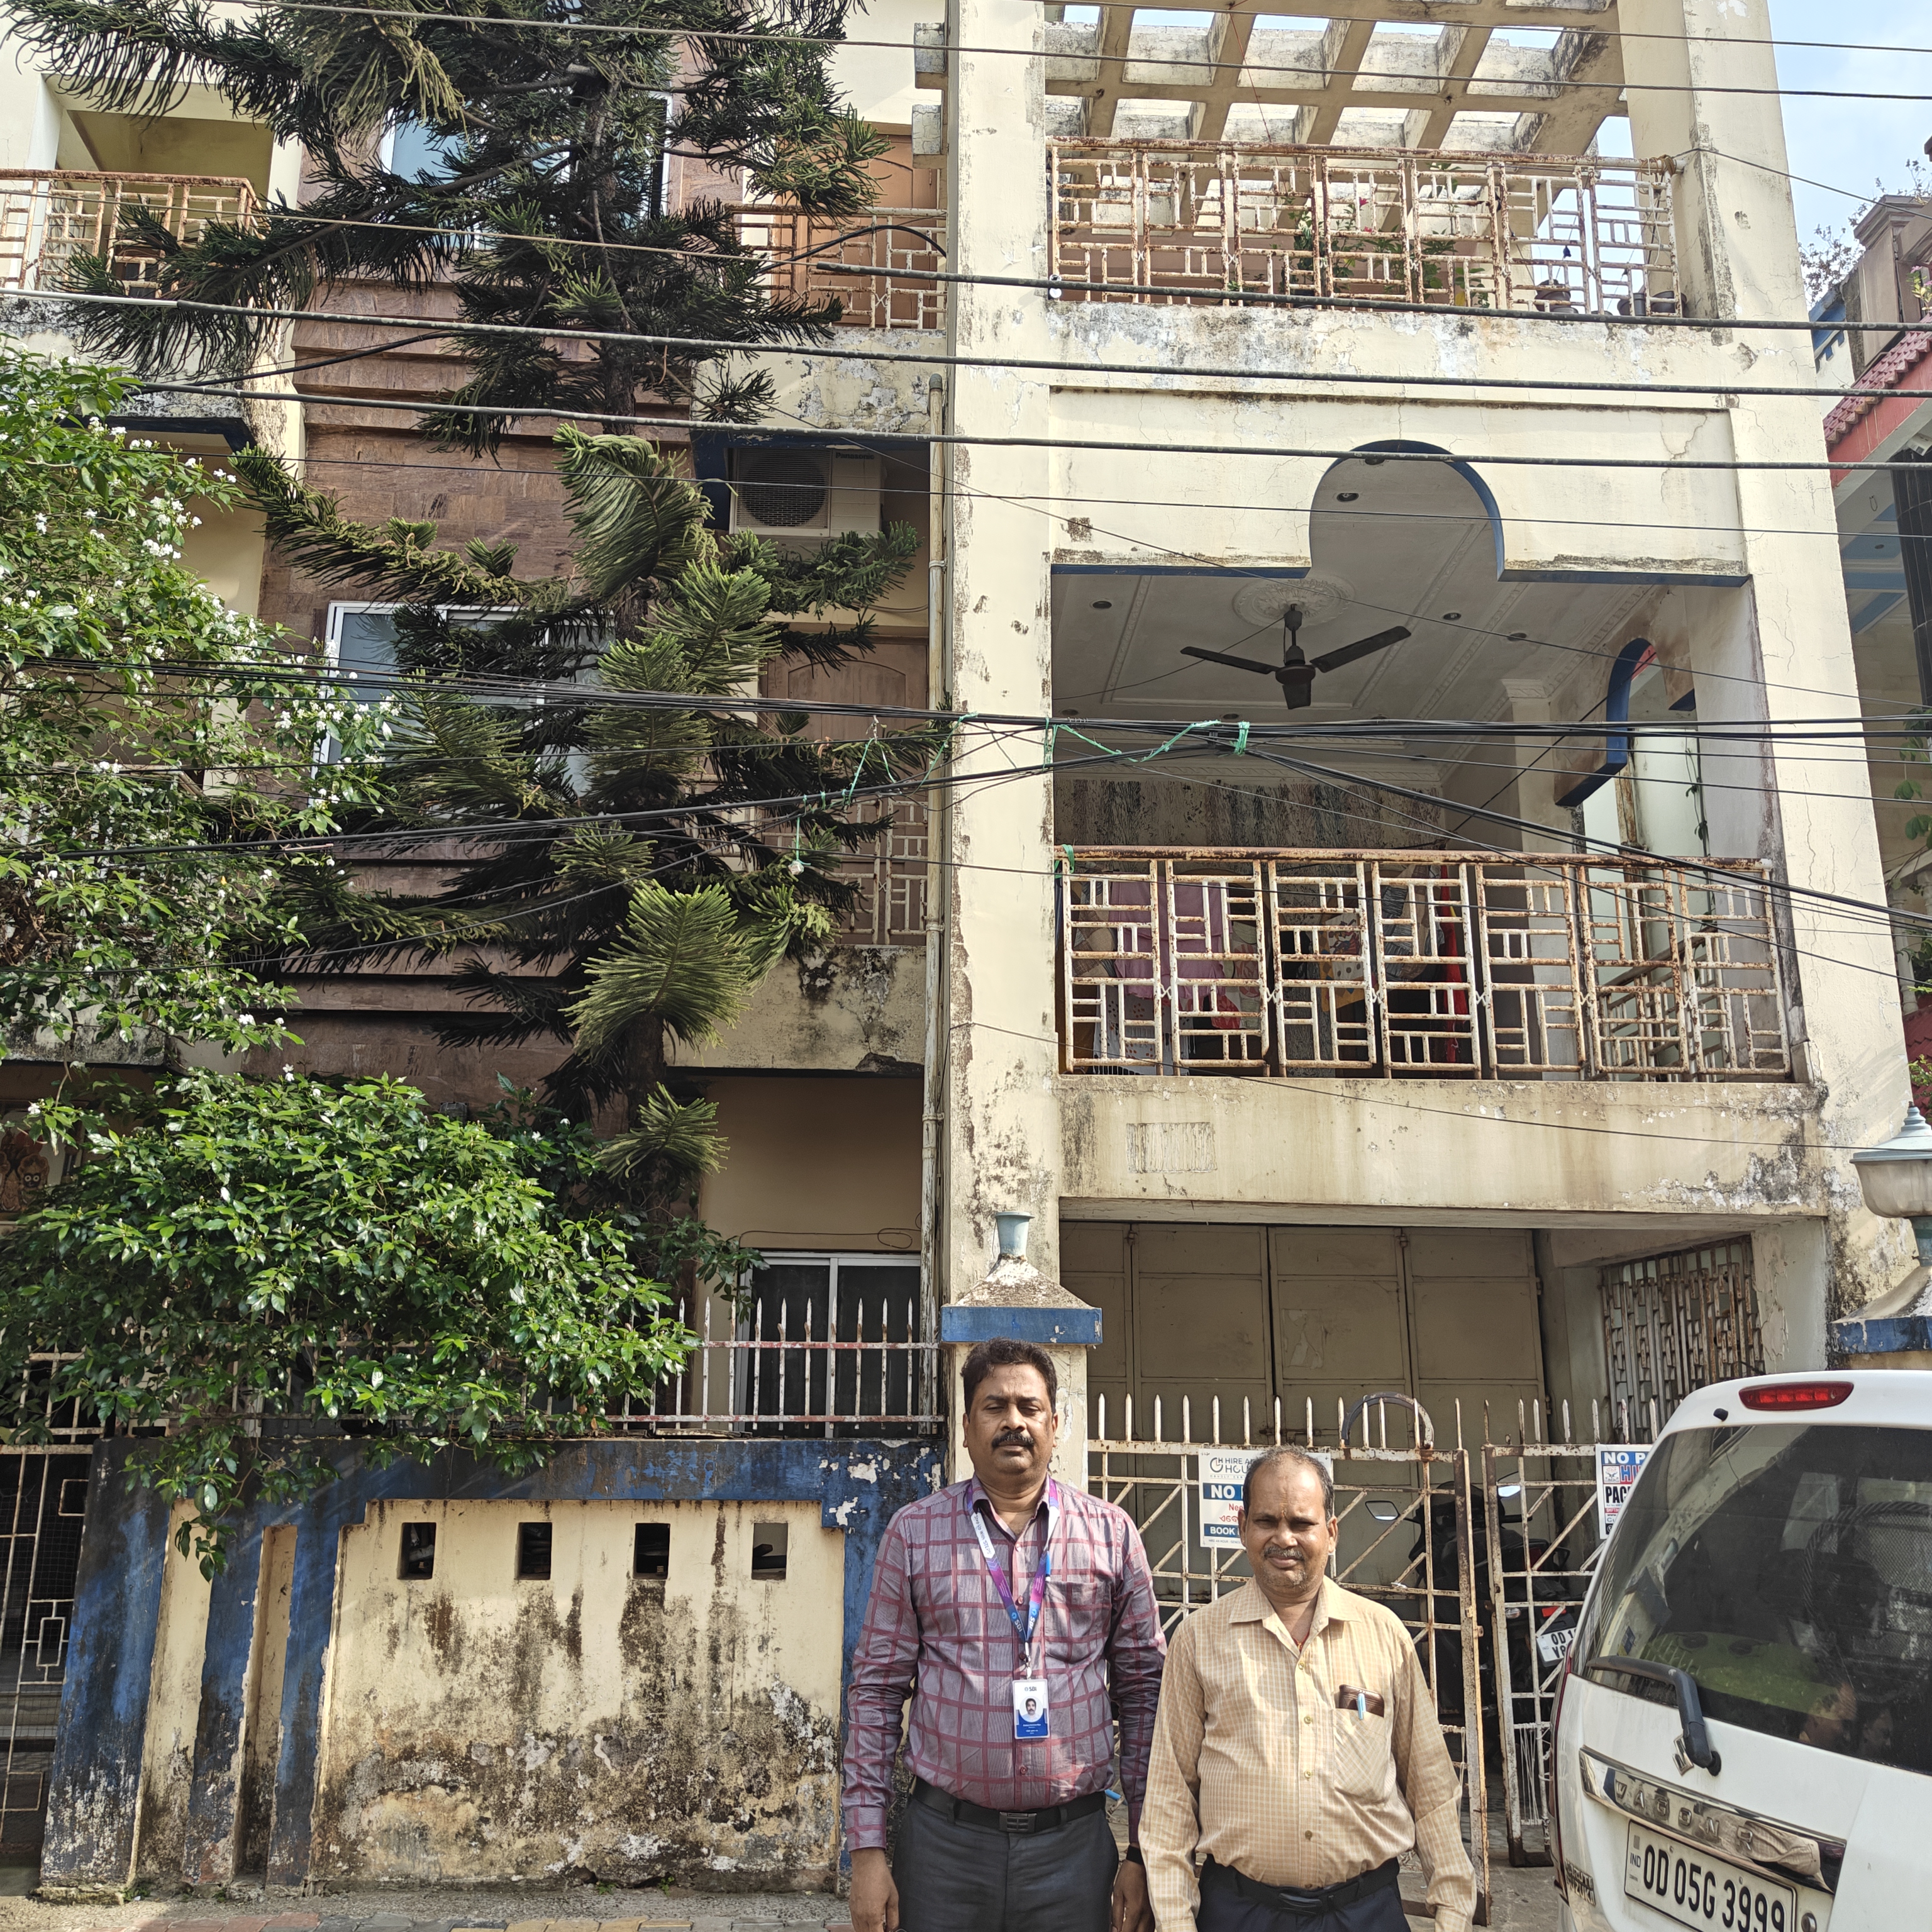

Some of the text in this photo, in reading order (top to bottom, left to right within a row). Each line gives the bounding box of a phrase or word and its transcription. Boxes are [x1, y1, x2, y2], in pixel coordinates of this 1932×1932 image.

[1604, 1452, 1629, 1464] NO
[1211, 1484, 1236, 1499] NO
[1605, 1486, 1631, 1503] PAC
[1210, 1526, 1235, 1535] BOOK
[1014, 1619, 1023, 1632] SBI
[1551, 1632, 1566, 1645] OD
[1629, 1852, 1641, 1868] IND
